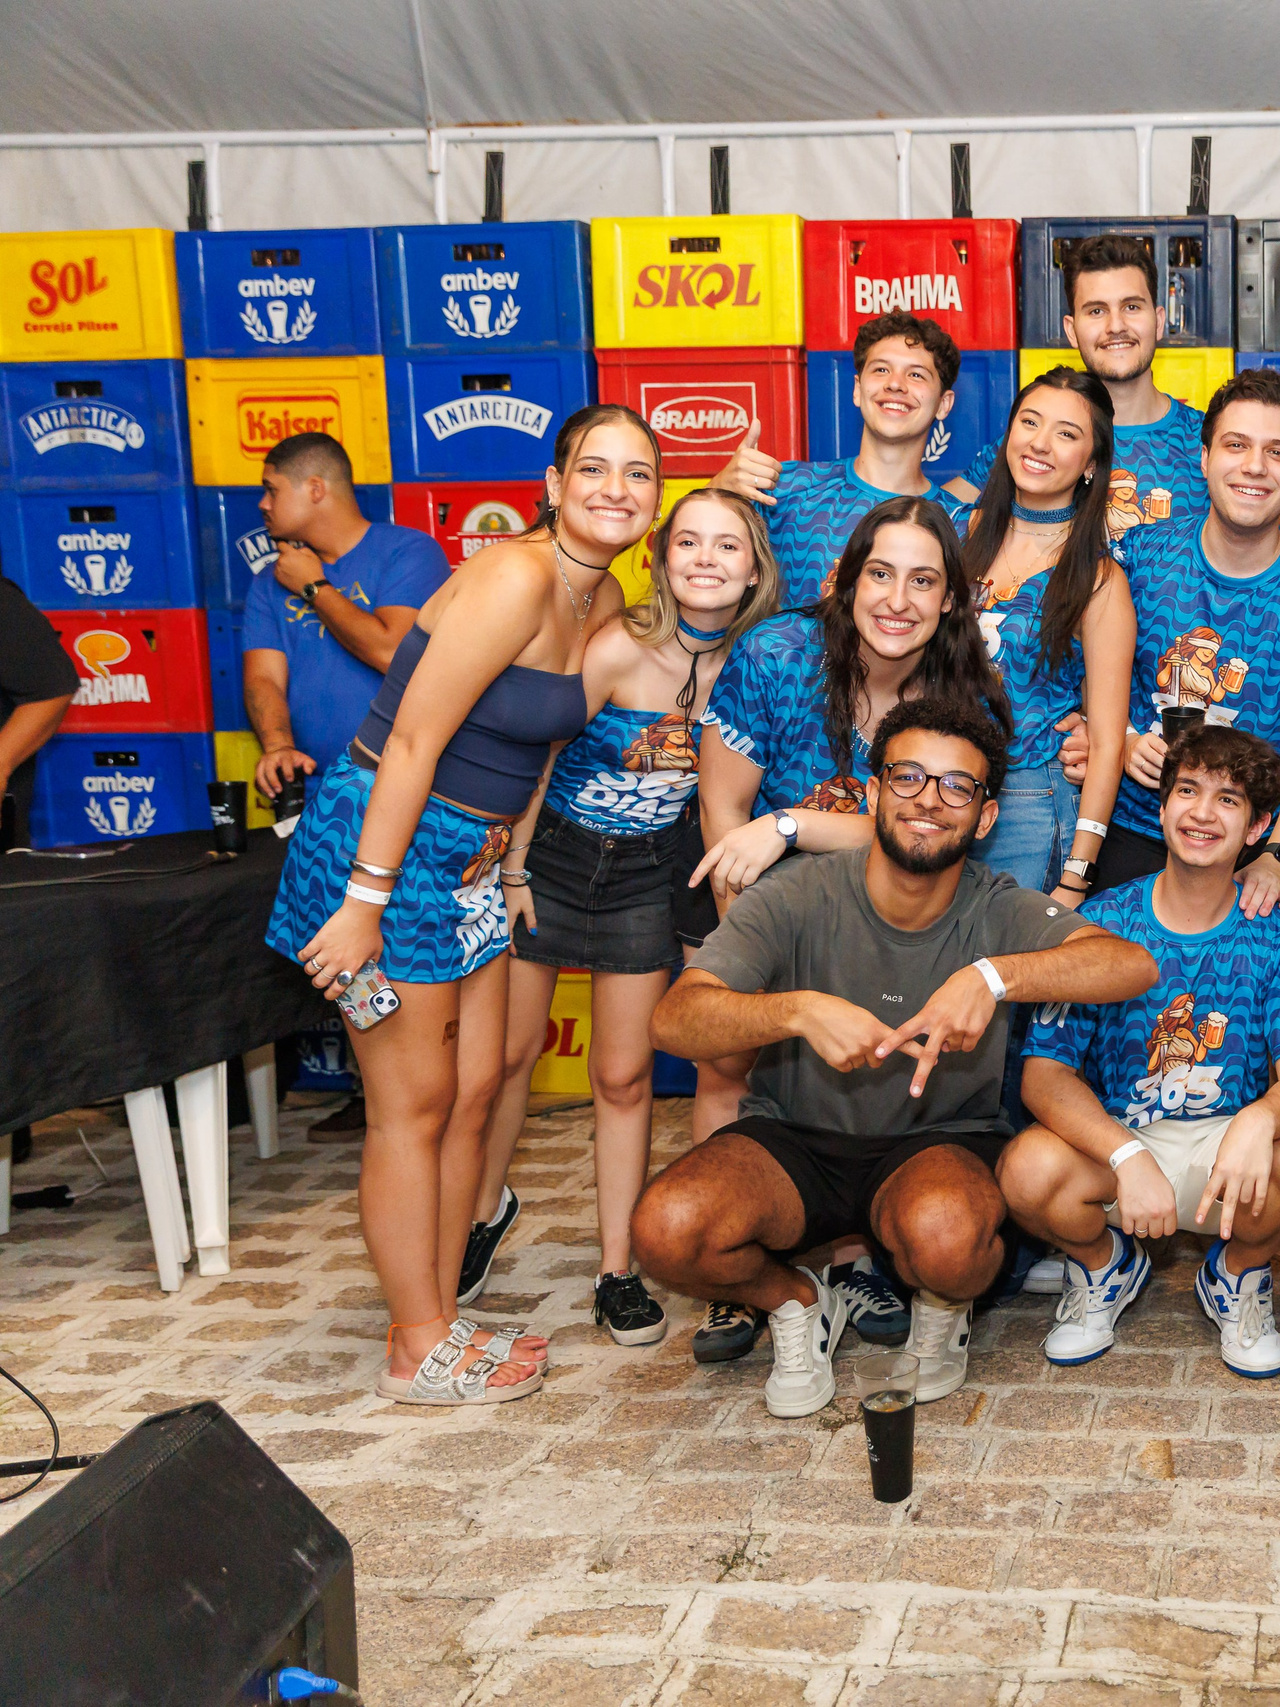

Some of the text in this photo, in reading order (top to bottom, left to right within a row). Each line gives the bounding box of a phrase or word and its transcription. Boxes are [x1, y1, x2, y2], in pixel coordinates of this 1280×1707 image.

[27, 256, 108, 318] SOL
[238, 273, 316, 298] ambev
[441, 267, 519, 292] ambev
[633, 263, 761, 310] SKOL
[854, 274, 963, 314] BRAHMA
[23, 320, 119, 333] Cerveja Pilsen
[27, 406, 128, 440] ANTARCTICA
[245, 409, 335, 440] Kaiser
[434, 401, 543, 435] ANTARCTICA
[650, 410, 750, 430] BRAHMA
[58, 528, 131, 551] ambev
[83, 772, 156, 793] ambev
[1125, 1064, 1224, 1117] 365
